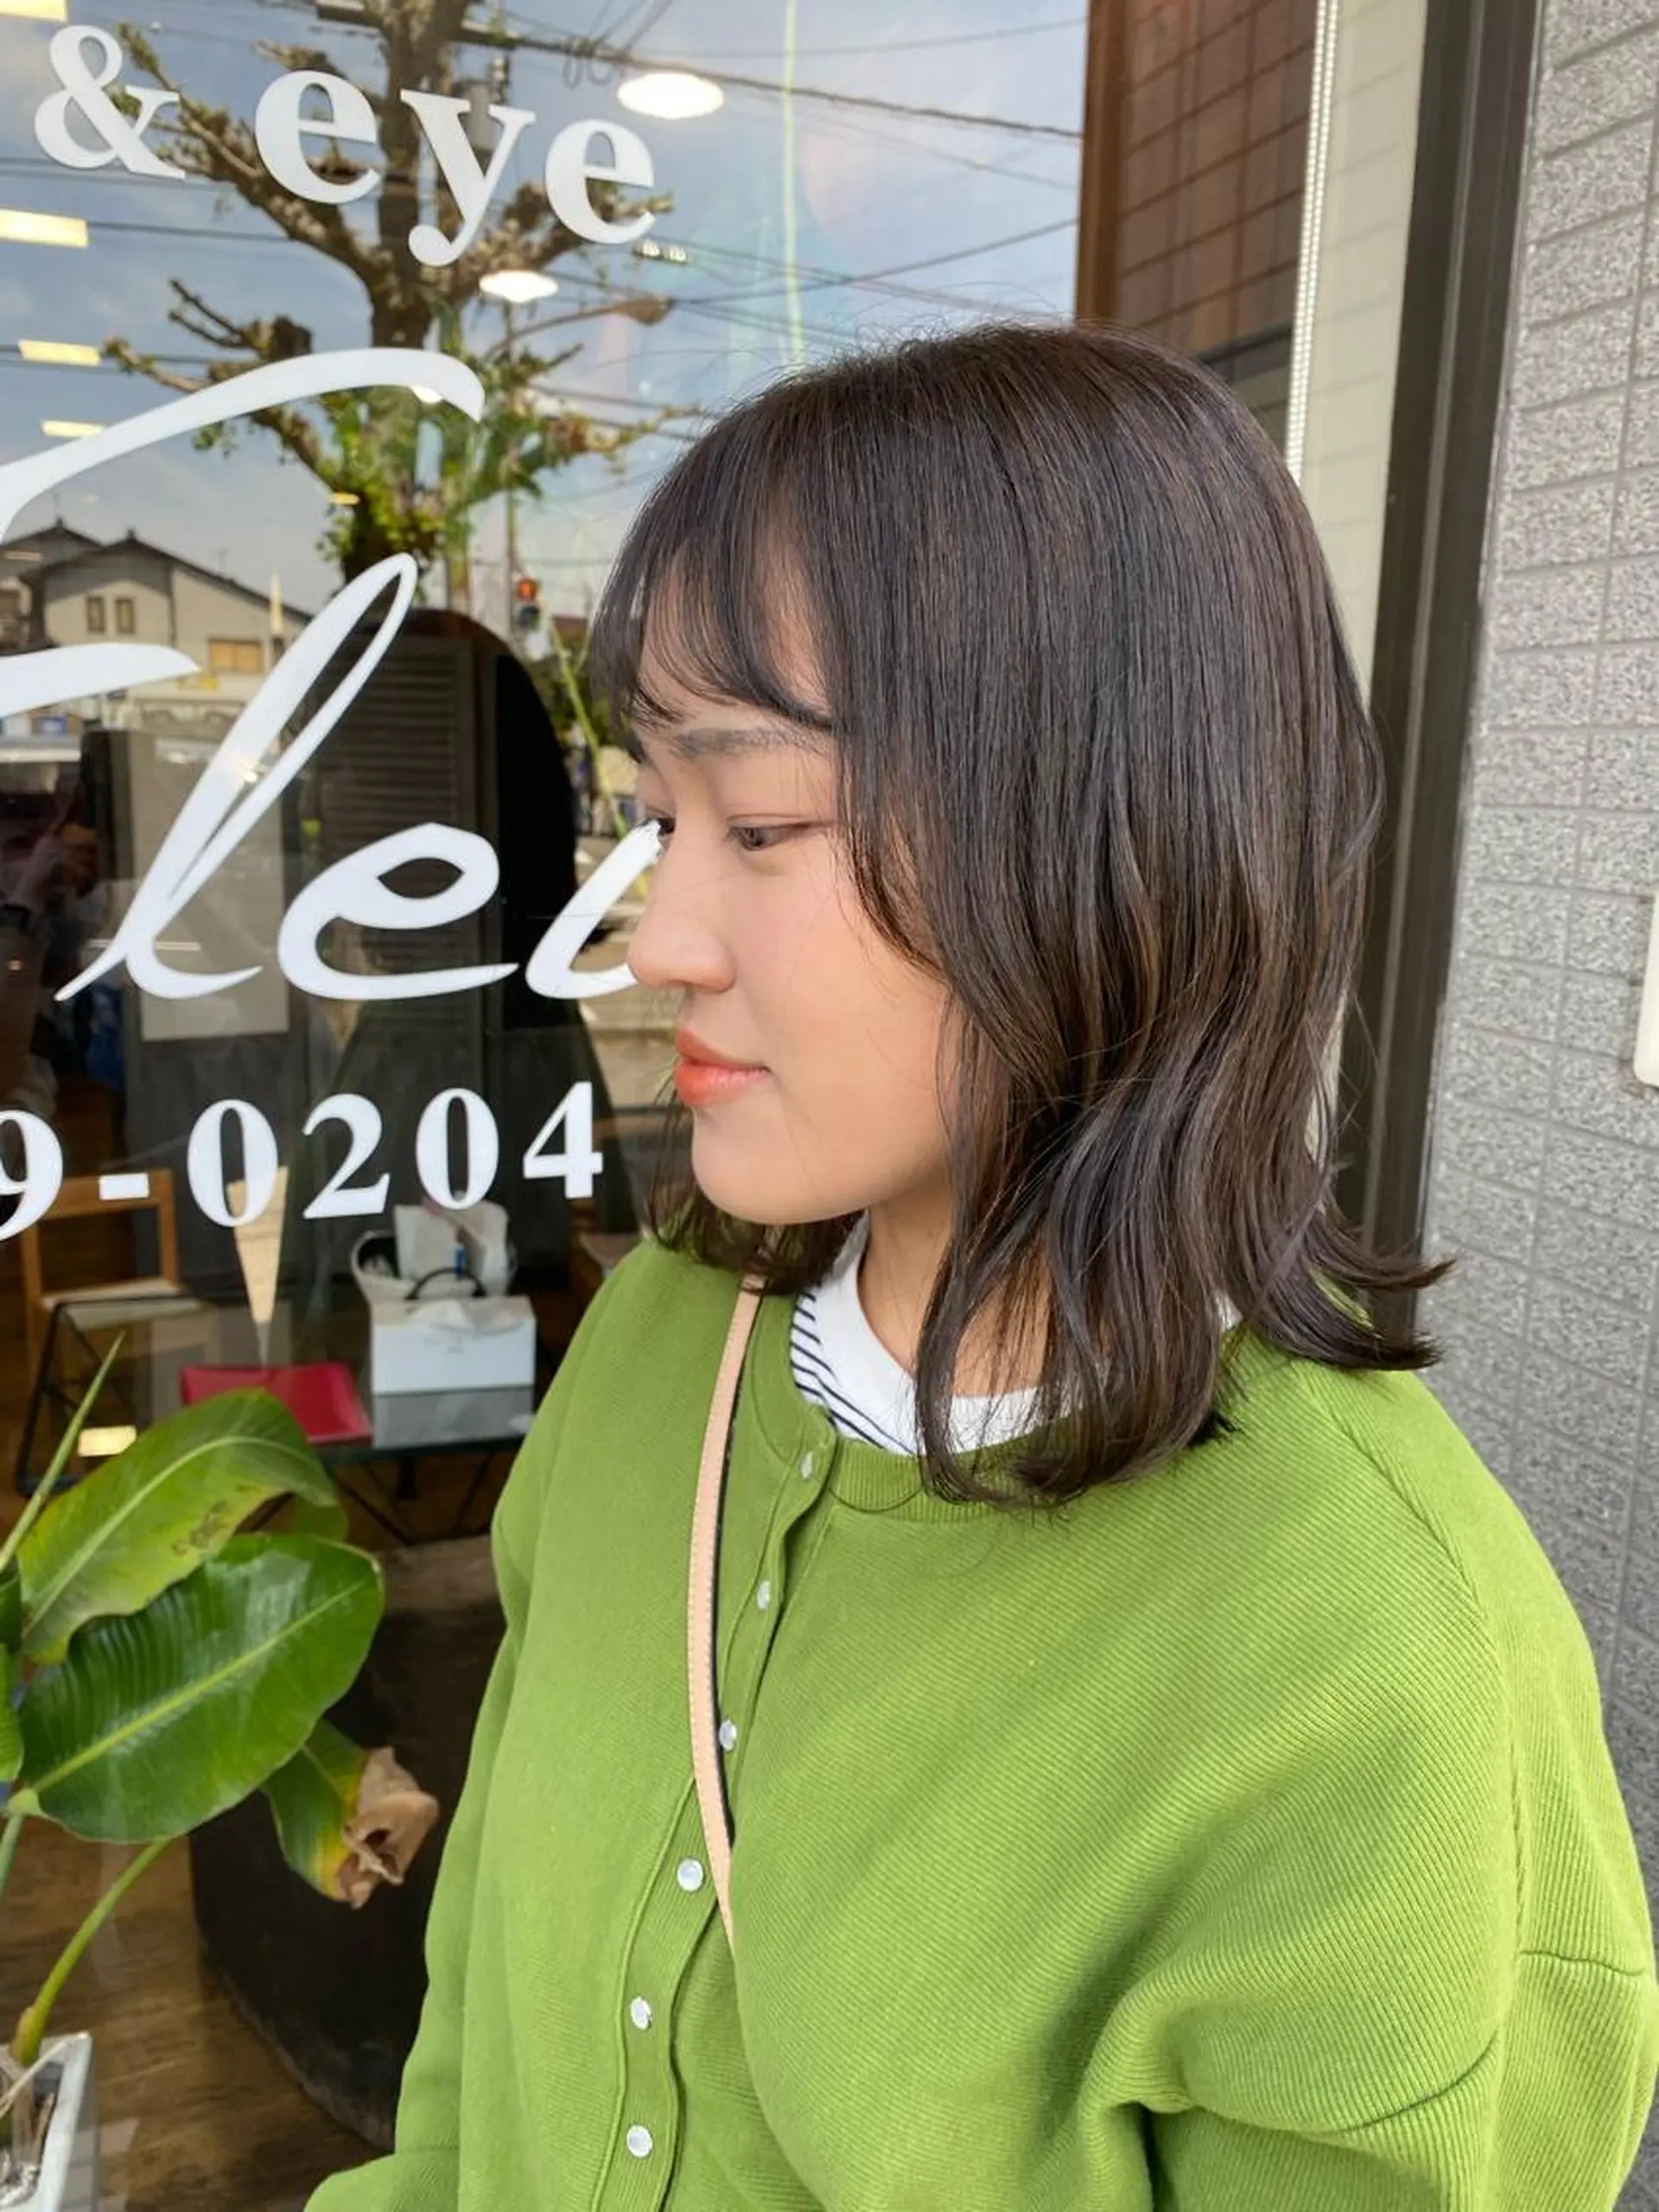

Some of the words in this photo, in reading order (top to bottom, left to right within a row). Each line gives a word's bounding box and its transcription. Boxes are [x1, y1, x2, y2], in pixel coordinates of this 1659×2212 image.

[35, 24, 185, 179] &
[255, 69, 657, 267] eye
[0, 1082, 604, 1241] 9-0204
